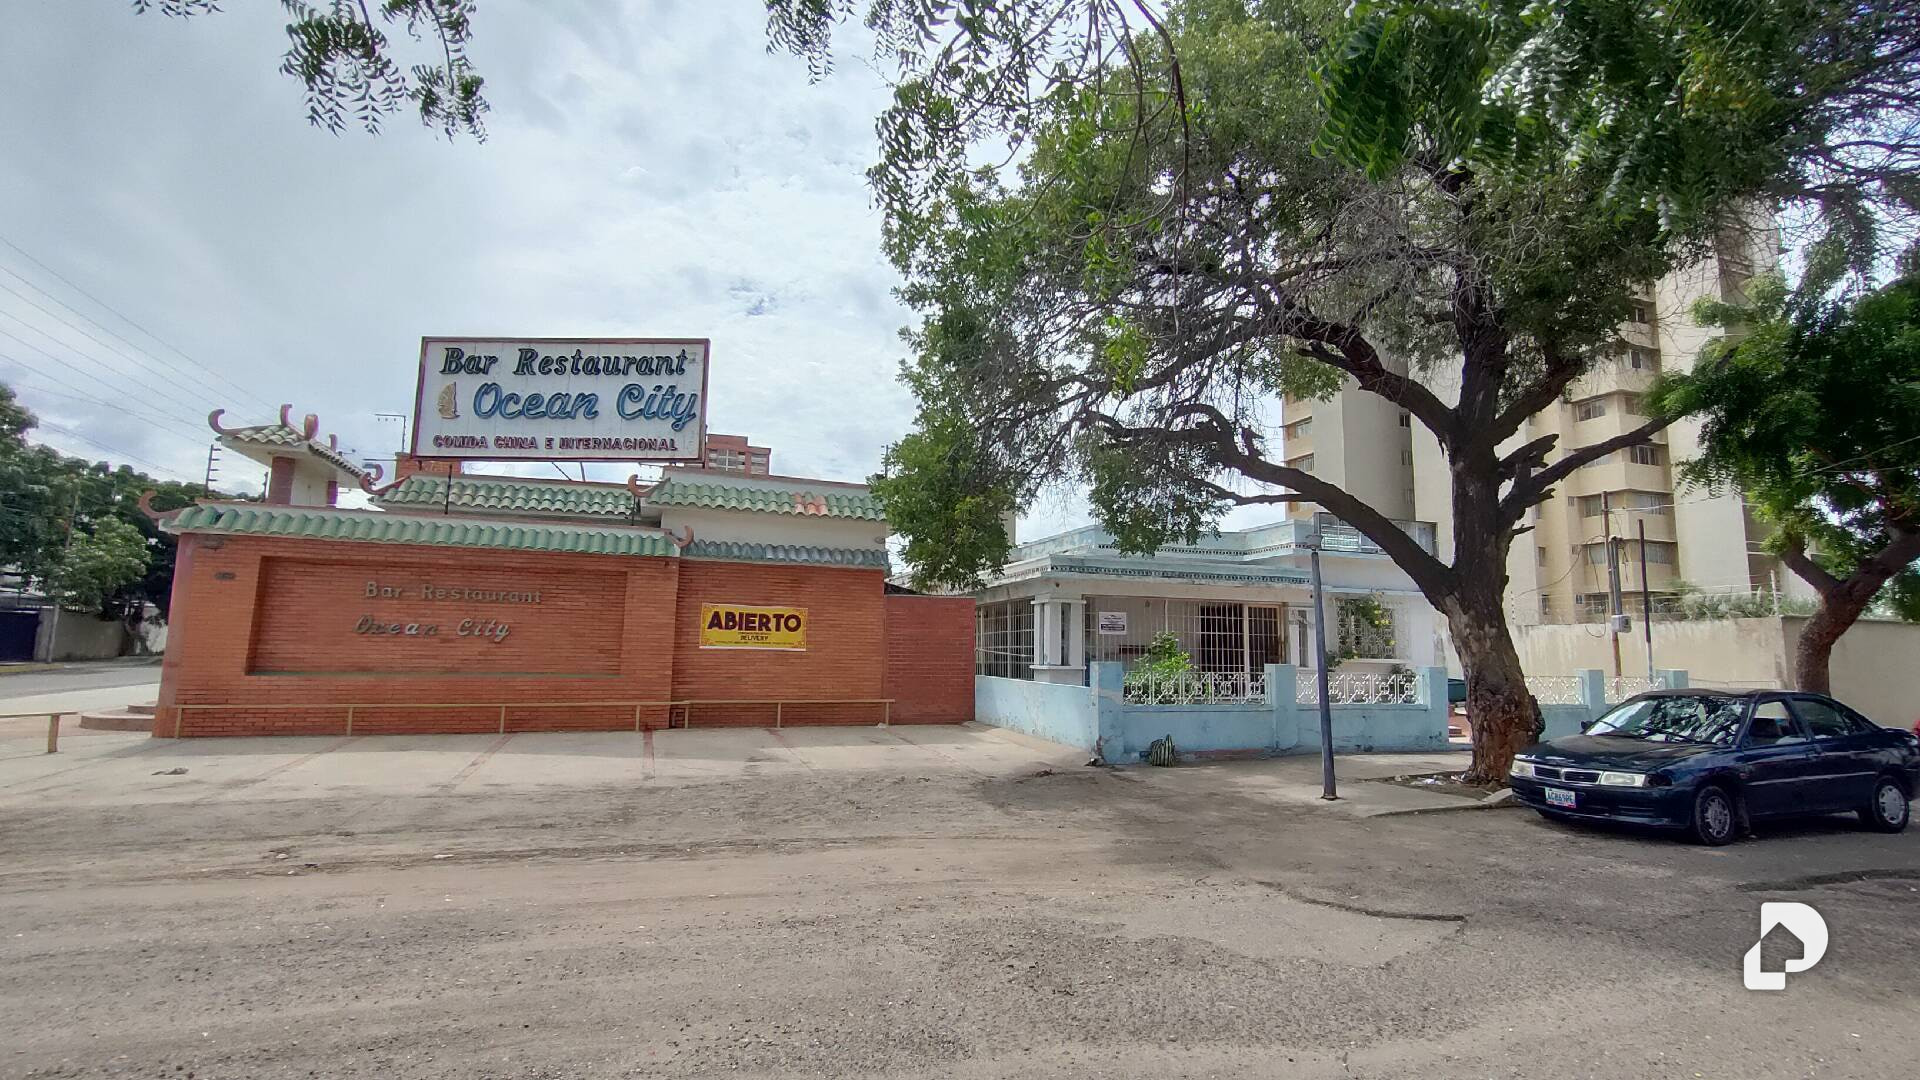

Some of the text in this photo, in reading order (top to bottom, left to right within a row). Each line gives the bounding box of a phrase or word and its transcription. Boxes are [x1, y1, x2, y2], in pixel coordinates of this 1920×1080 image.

[440, 347, 689, 376] Bar Restaurant
[473, 382, 697, 432] Ocean City
[433, 434, 679, 452] COMIDA CHINA E INTERNACIONAL
[365, 581, 542, 603] Bar Restaurant
[355, 614, 511, 643] Ocean City
[707, 611, 802, 633] ABIERTO
